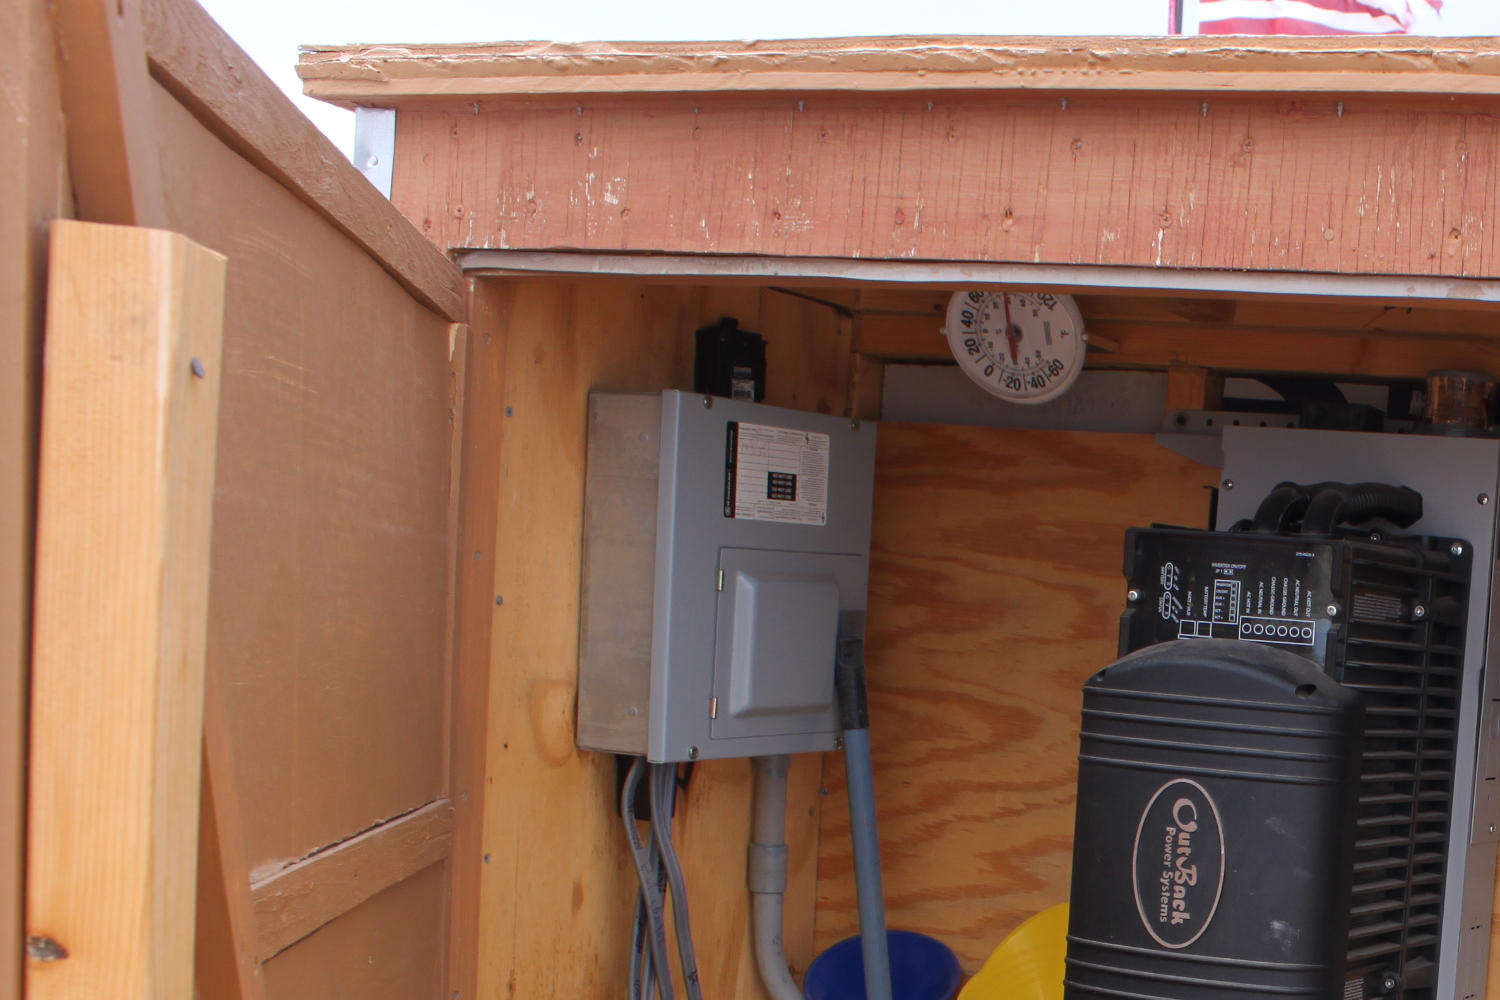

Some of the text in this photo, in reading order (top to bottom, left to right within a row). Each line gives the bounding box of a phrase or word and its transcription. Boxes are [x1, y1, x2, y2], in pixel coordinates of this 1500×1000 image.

[960, 310, 975, 328] 40
[964, 338, 981, 356] 20
[984, 364, 995, 377] 0
[1047, 358, 1064, 380] -60
[1003, 375, 1022, 391] -20
[1027, 375, 1046, 390] -40
[1172, 798, 1198, 925] OutBack
[1159, 826, 1177, 923] Power Systems
